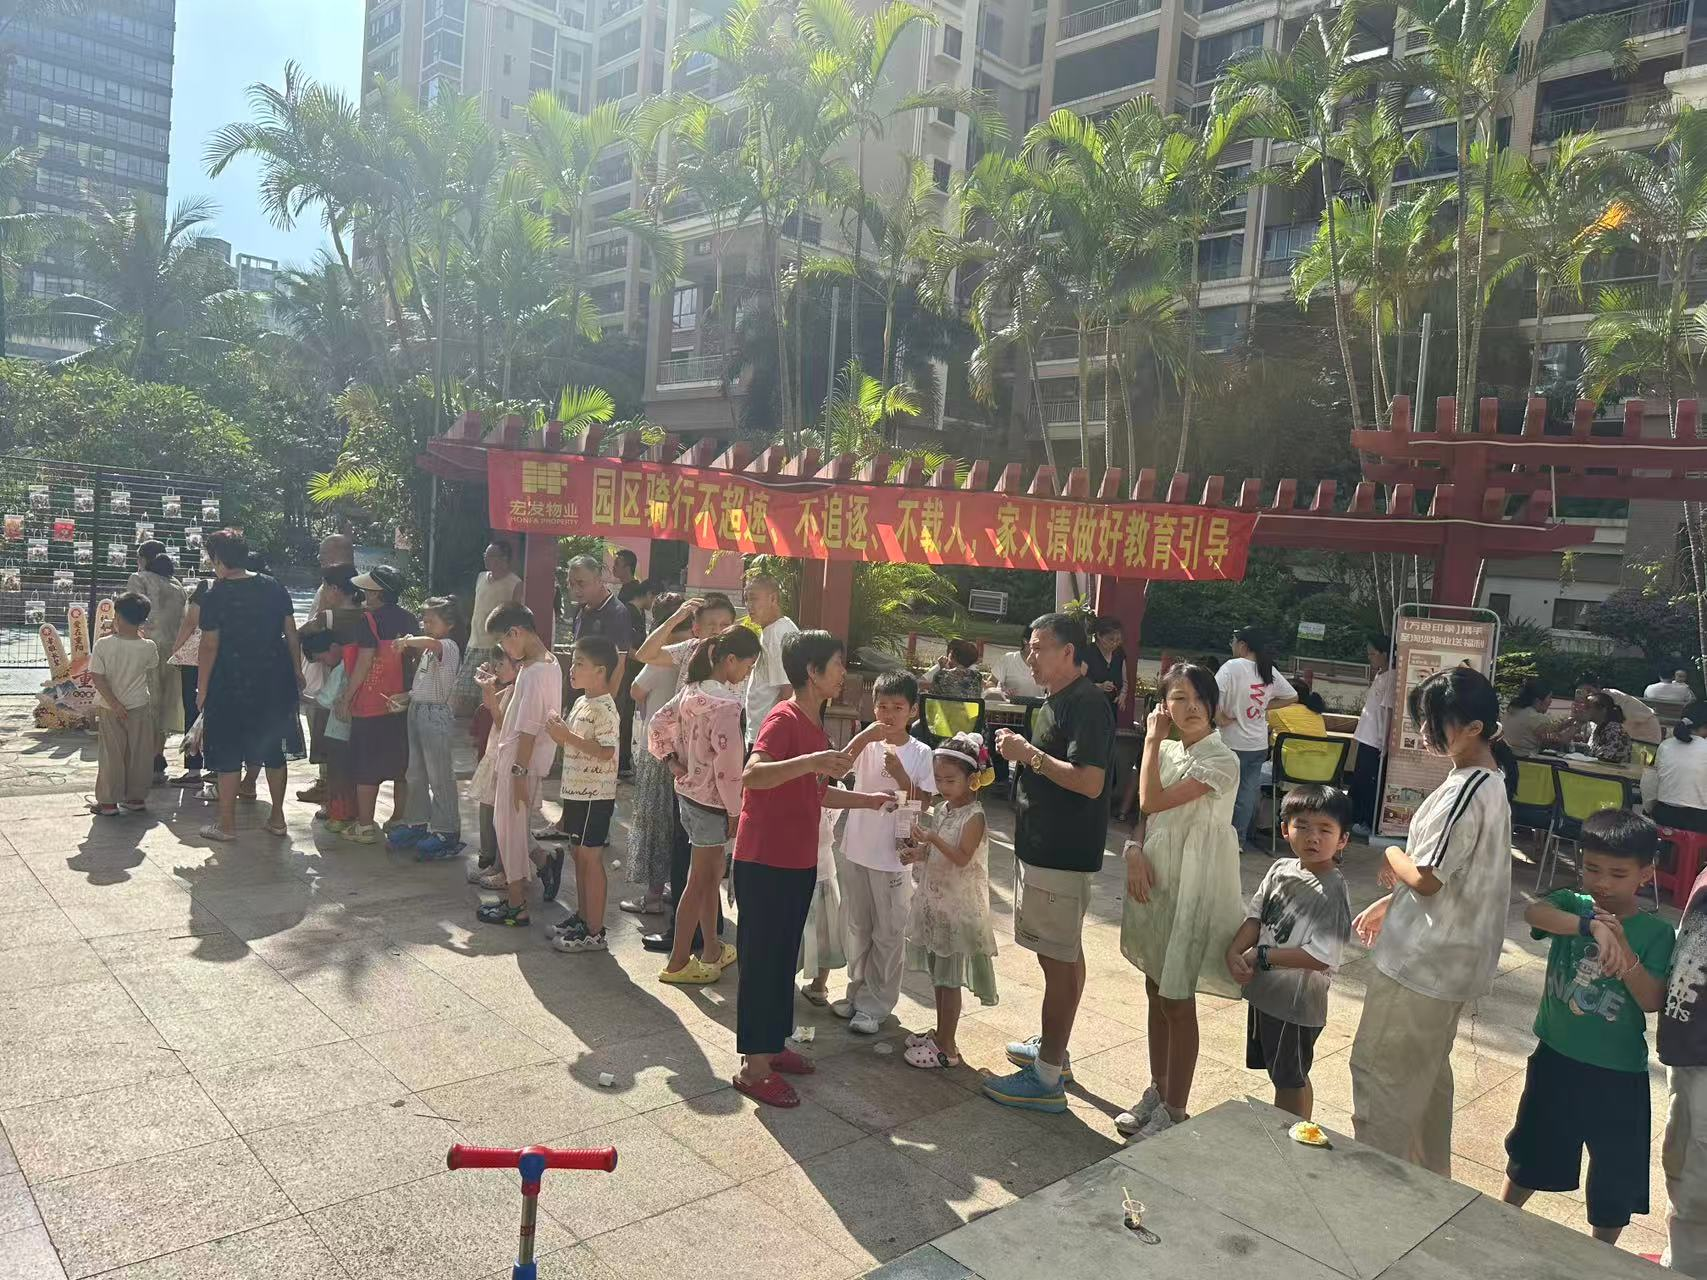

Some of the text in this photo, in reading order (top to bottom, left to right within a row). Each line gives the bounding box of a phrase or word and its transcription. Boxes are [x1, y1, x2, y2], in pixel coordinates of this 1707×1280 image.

[509, 500, 579, 519] 宏发物业
[540, 518, 579, 526] PROPERTY
